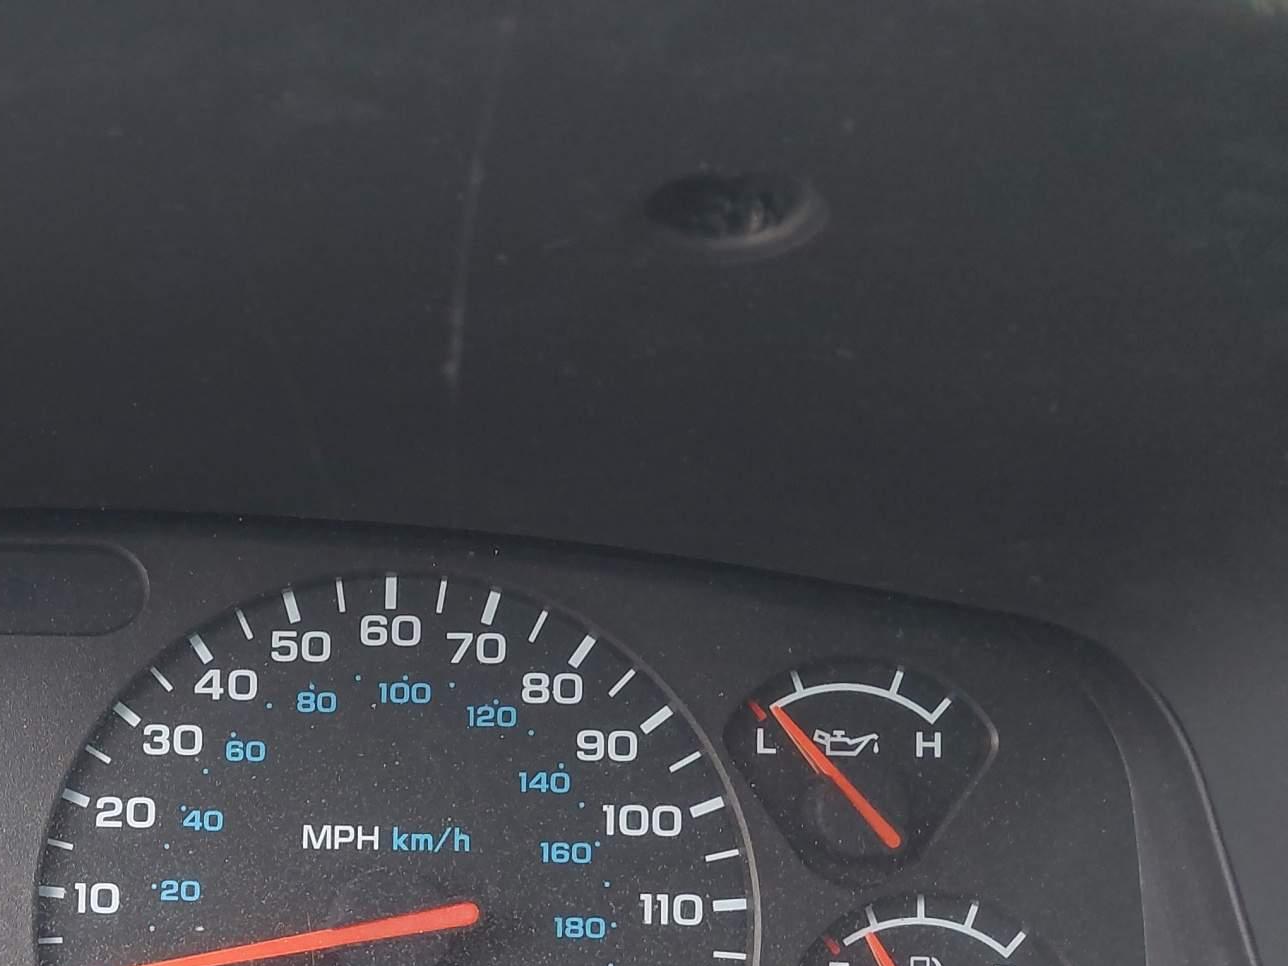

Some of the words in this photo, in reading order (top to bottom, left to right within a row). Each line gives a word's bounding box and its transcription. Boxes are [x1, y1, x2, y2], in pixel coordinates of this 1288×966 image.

[360, 614, 422, 647] 60
[270, 630, 332, 663] 50
[446, 632, 507, 664] 70
[194, 669, 258, 701] 40
[378, 682, 432, 705] 100
[521, 672, 583, 705] 80
[296, 691, 337, 713] 80
[466, 705, 518, 727] 120
[142, 724, 203, 756] 30
[225, 740, 266, 762] 60
[576, 730, 638, 762] 90
[756, 728, 777, 754] L
[915, 731, 942, 758] H
[518, 771, 570, 793] 140
[95, 797, 156, 828] 20
[182, 810, 224, 832] 40
[602, 804, 682, 837] 100
[301, 825, 380, 850] MPH
[392, 827, 471, 853] km/h
[540, 842, 592, 864] 160
[74, 882, 120, 914] 10
[161, 880, 201, 902] 20
[640, 893, 703, 926] 110
[554, 917, 606, 939] 180
